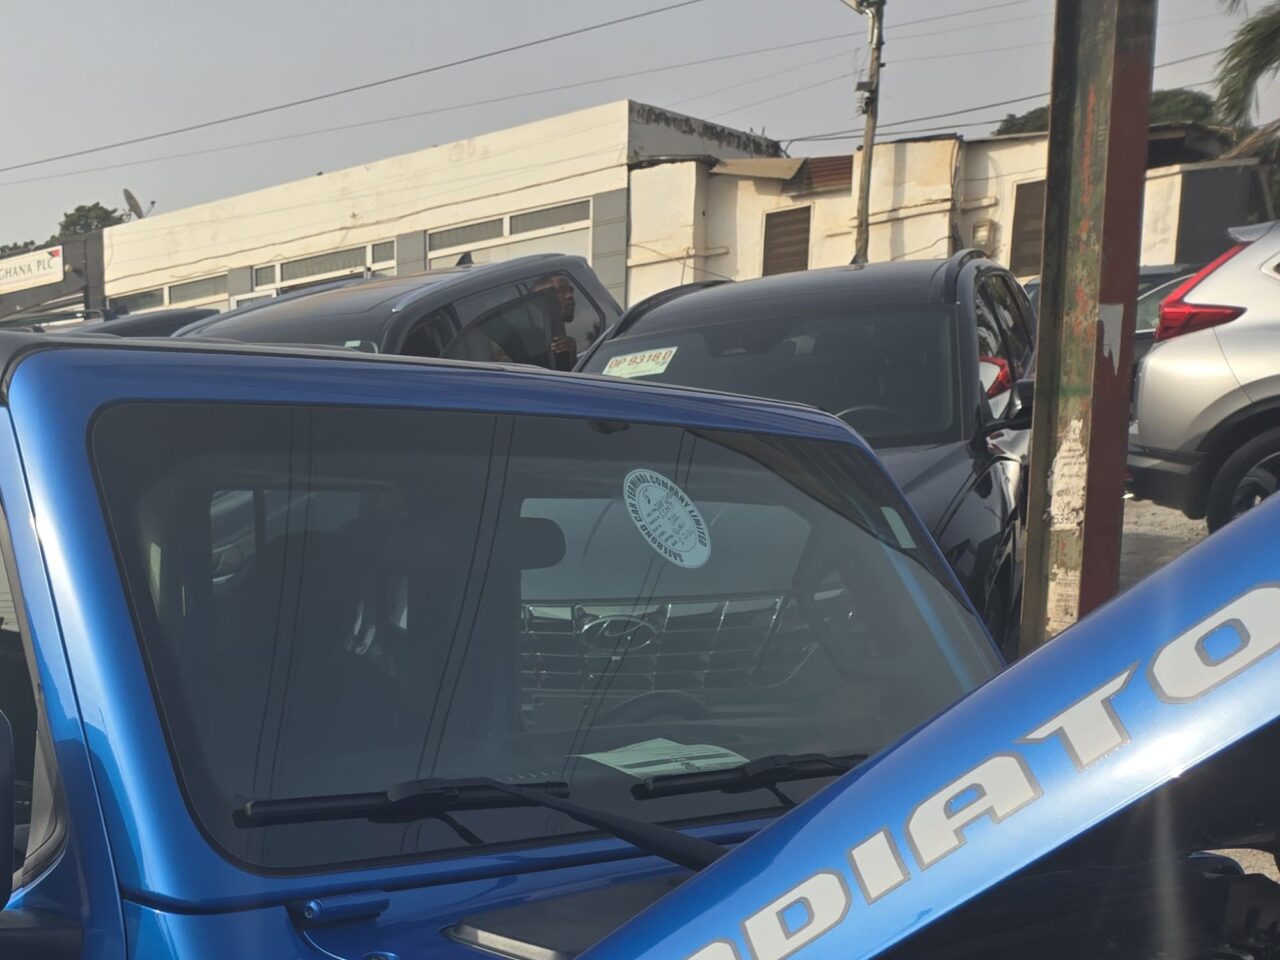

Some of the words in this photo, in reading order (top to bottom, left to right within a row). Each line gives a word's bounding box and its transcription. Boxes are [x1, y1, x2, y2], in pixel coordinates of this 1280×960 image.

[37, 257, 55, 271] PLC
[628, 501, 643, 522] CAR
[649, 474, 690, 507] COMPANY
[688, 509, 707, 547] LIMITED
